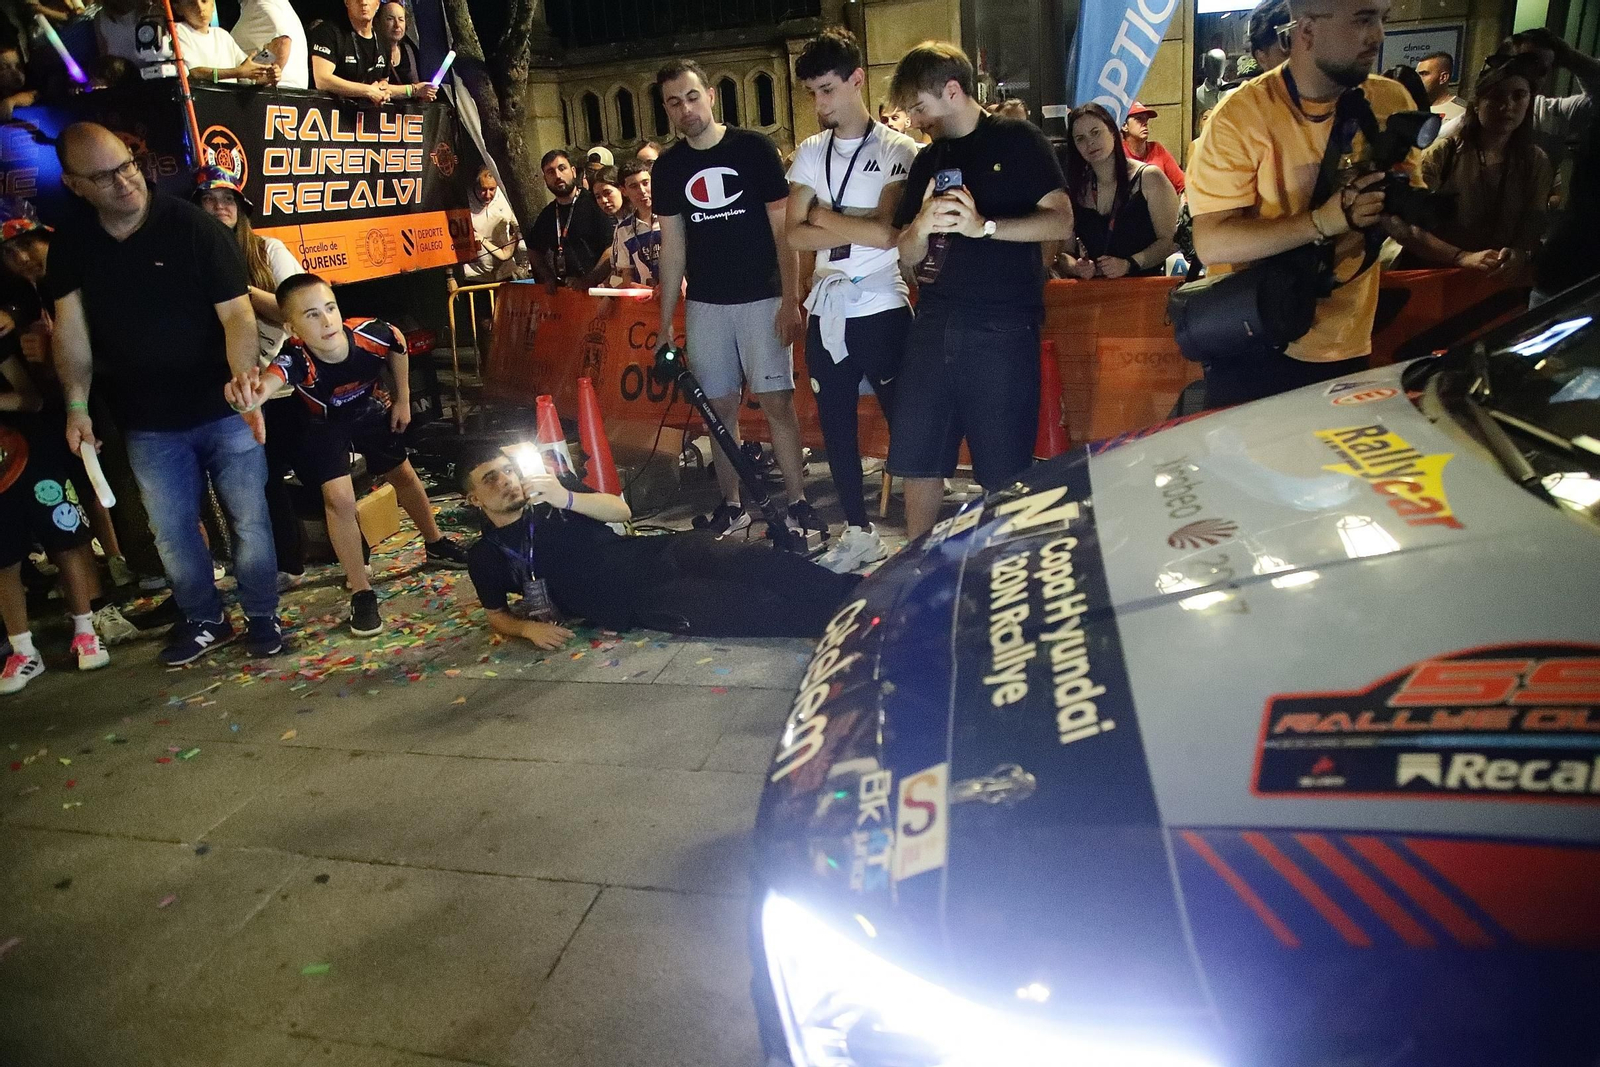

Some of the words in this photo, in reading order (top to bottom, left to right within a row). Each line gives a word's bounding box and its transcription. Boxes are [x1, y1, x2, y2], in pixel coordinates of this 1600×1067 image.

[264, 105, 424, 143] RALLYE
[263, 147, 424, 176] OURENSE
[263, 178, 423, 216] RECALVI
[691, 209, 746, 223] Champion
[418, 227, 444, 239] DEPORTE
[420, 240, 444, 252] GALEGO
[299, 242, 329, 255] Concello
[329, 241, 338, 251] de
[302, 254, 348, 270] OURENSE
[1033, 537, 1078, 600] Copa
[983, 603, 1037, 707] Rallye
[1039, 593, 1116, 744] Hyundai
[1274, 709, 1517, 734] RALLYE
